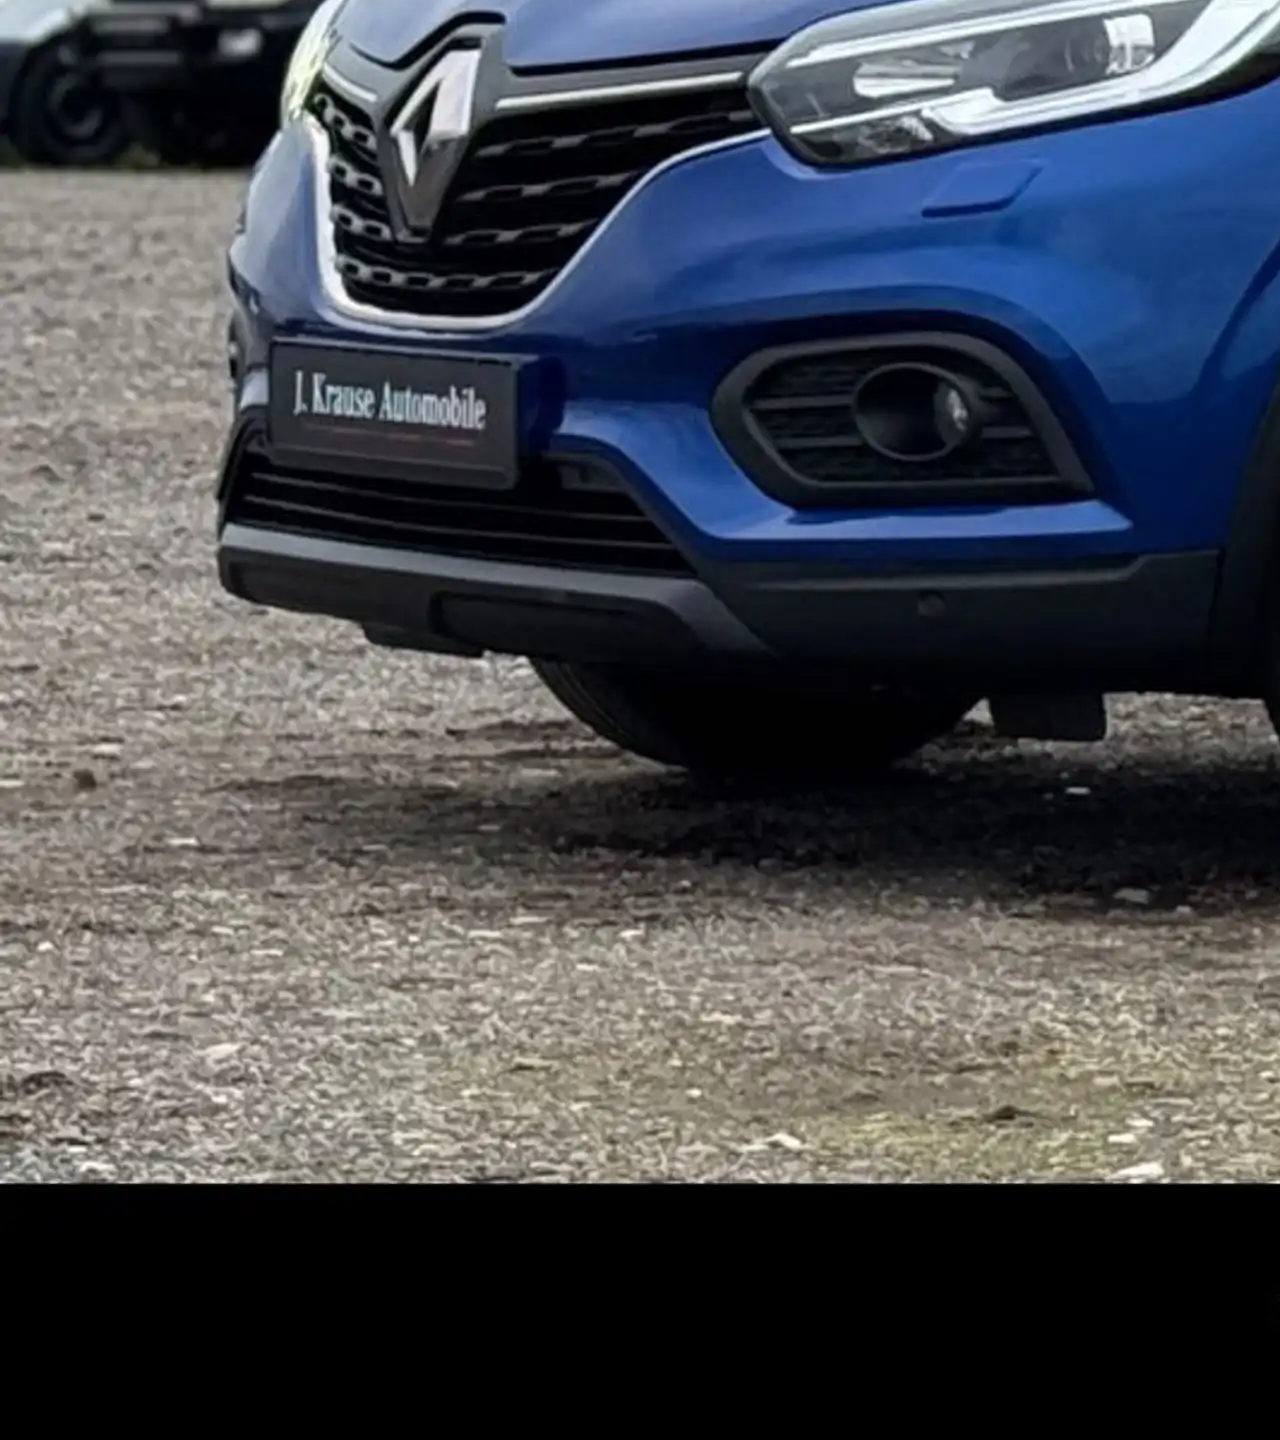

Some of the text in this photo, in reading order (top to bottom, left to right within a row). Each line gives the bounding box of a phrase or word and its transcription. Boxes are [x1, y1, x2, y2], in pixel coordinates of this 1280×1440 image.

[292, 369, 487, 431] J. Krause Automobile
